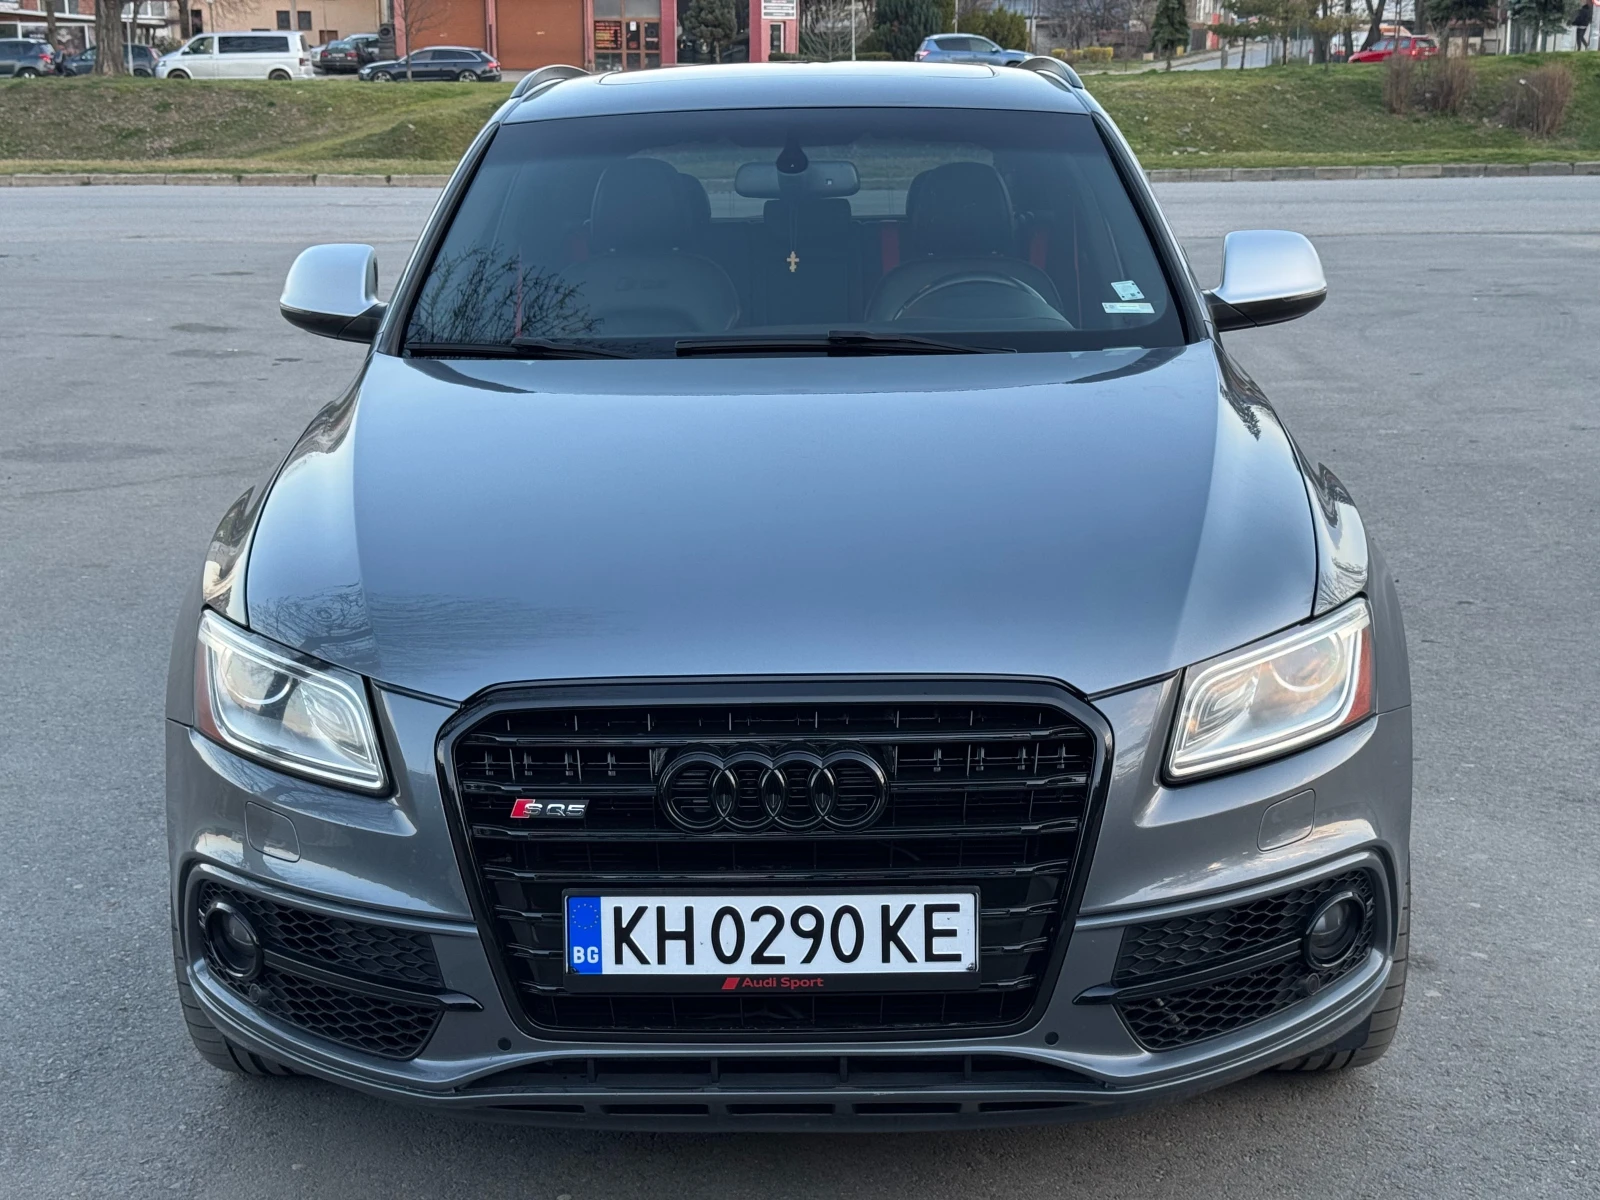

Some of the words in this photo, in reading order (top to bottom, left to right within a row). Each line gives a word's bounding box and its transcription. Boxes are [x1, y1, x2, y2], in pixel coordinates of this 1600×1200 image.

[523, 803, 586, 817] SQ5
[613, 905, 695, 966] KH
[711, 904, 865, 965] 0290
[880, 903, 962, 964] KE
[573, 946, 599, 964] BG
[742, 977, 777, 988] Audi
[780, 977, 824, 990] Sport
